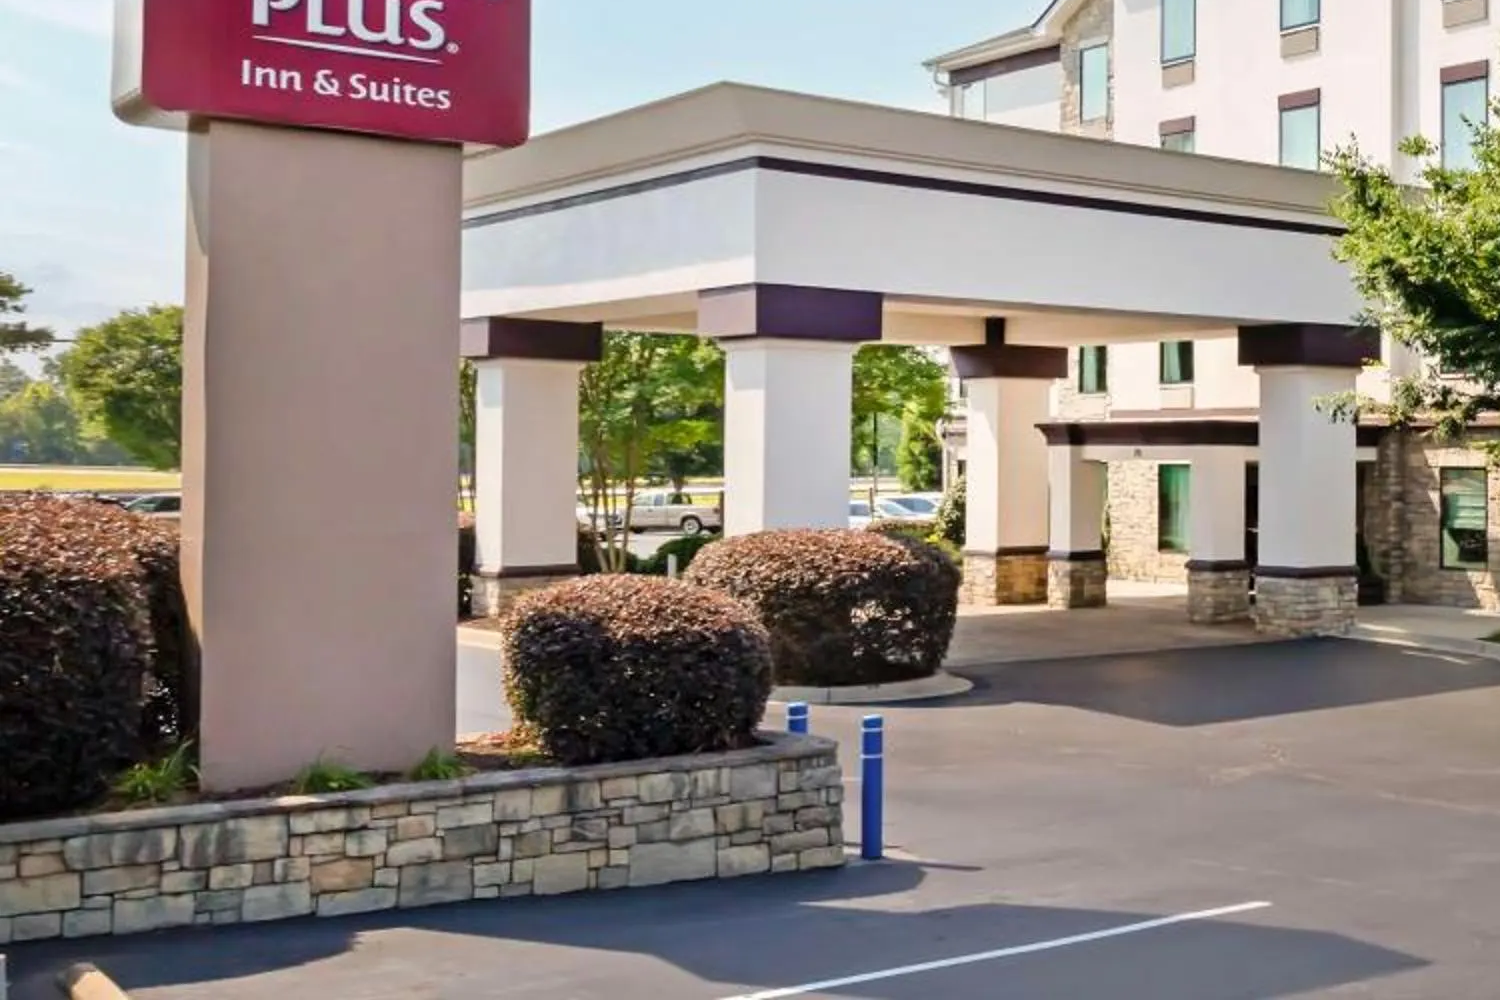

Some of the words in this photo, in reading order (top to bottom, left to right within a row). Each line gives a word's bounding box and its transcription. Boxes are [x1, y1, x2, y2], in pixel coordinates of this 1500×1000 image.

[241, 59, 302, 92] Inn
[313, 69, 340, 96] &
[349, 73, 451, 110] Suites
